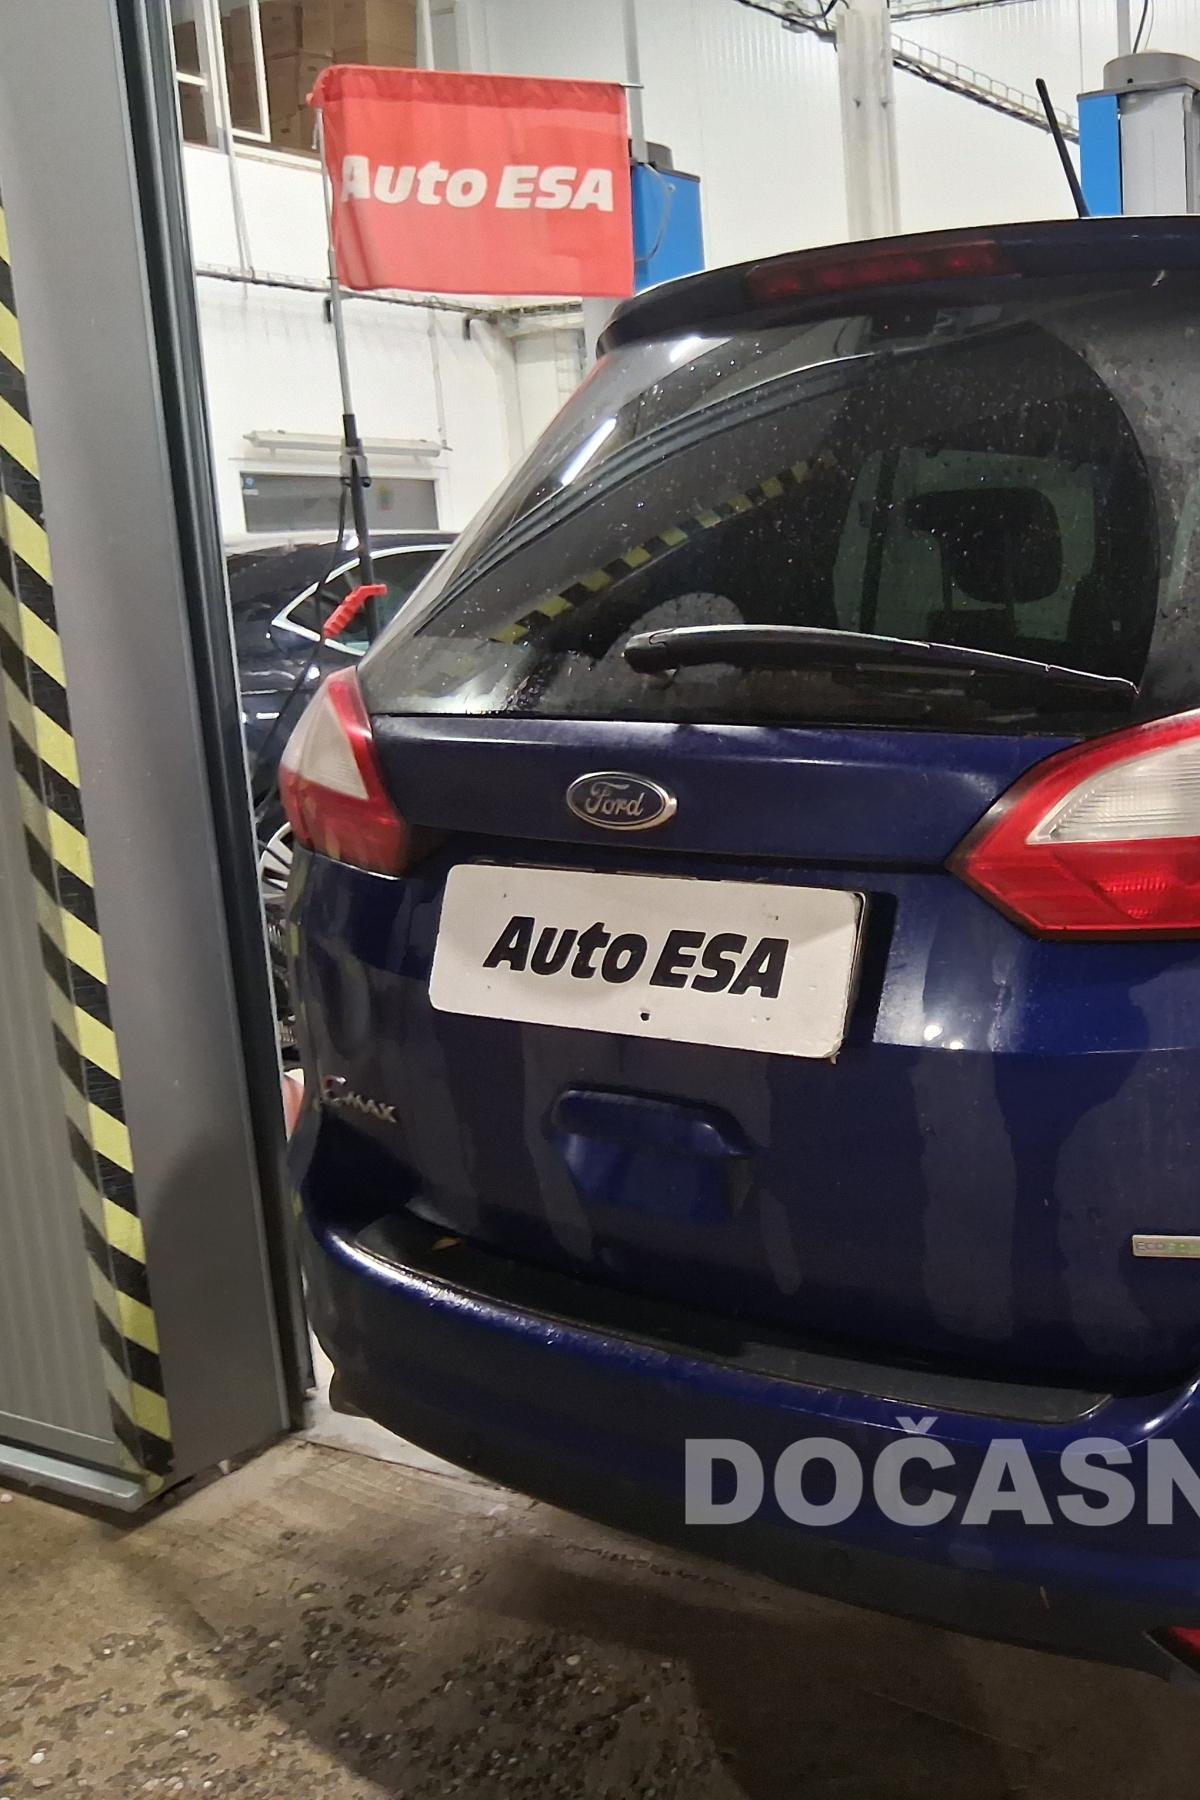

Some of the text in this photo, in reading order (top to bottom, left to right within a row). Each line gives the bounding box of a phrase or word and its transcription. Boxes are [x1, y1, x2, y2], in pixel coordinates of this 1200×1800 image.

[340, 155, 614, 212] Auto ESA
[585, 781, 645, 816] Ford
[482, 916, 789, 999] Auto ESA
